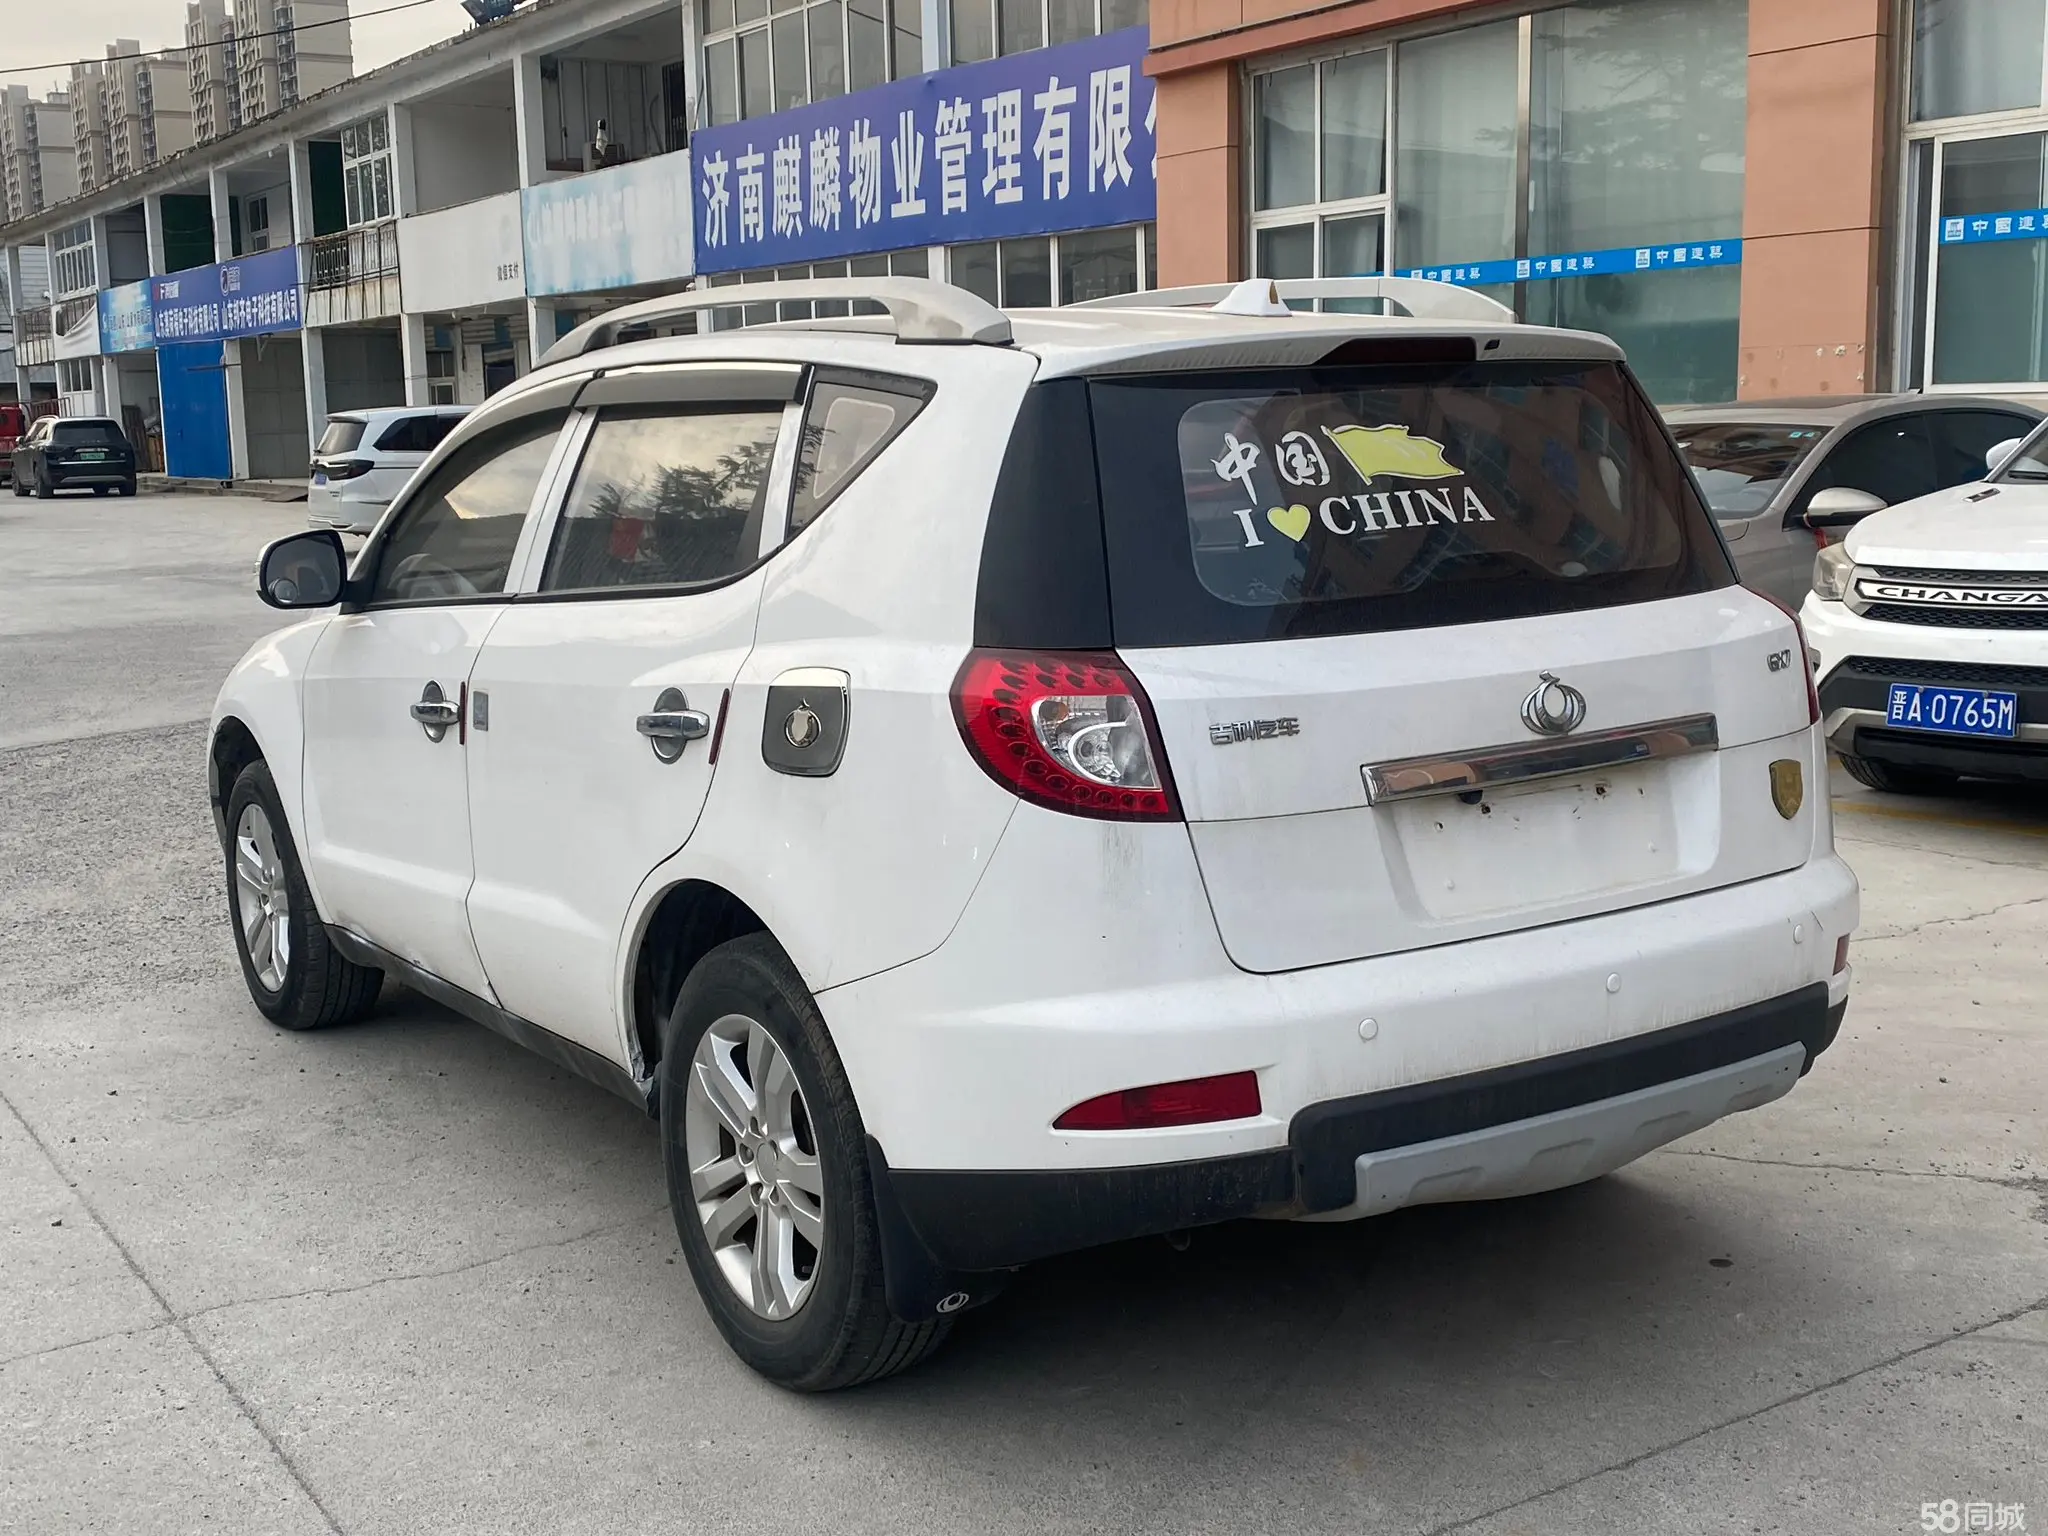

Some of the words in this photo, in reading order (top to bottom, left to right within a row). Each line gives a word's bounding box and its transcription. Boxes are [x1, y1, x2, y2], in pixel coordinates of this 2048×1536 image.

[700, 65, 1157, 248] 济南麒麟物业管理有限
[1210, 431, 1331, 506] 中国
[1232, 507, 1266, 548] I
[1318, 485, 1497, 535] CHINA
[1766, 649, 1791, 672] GX7
[1209, 717, 1301, 745] 吉利汽车
